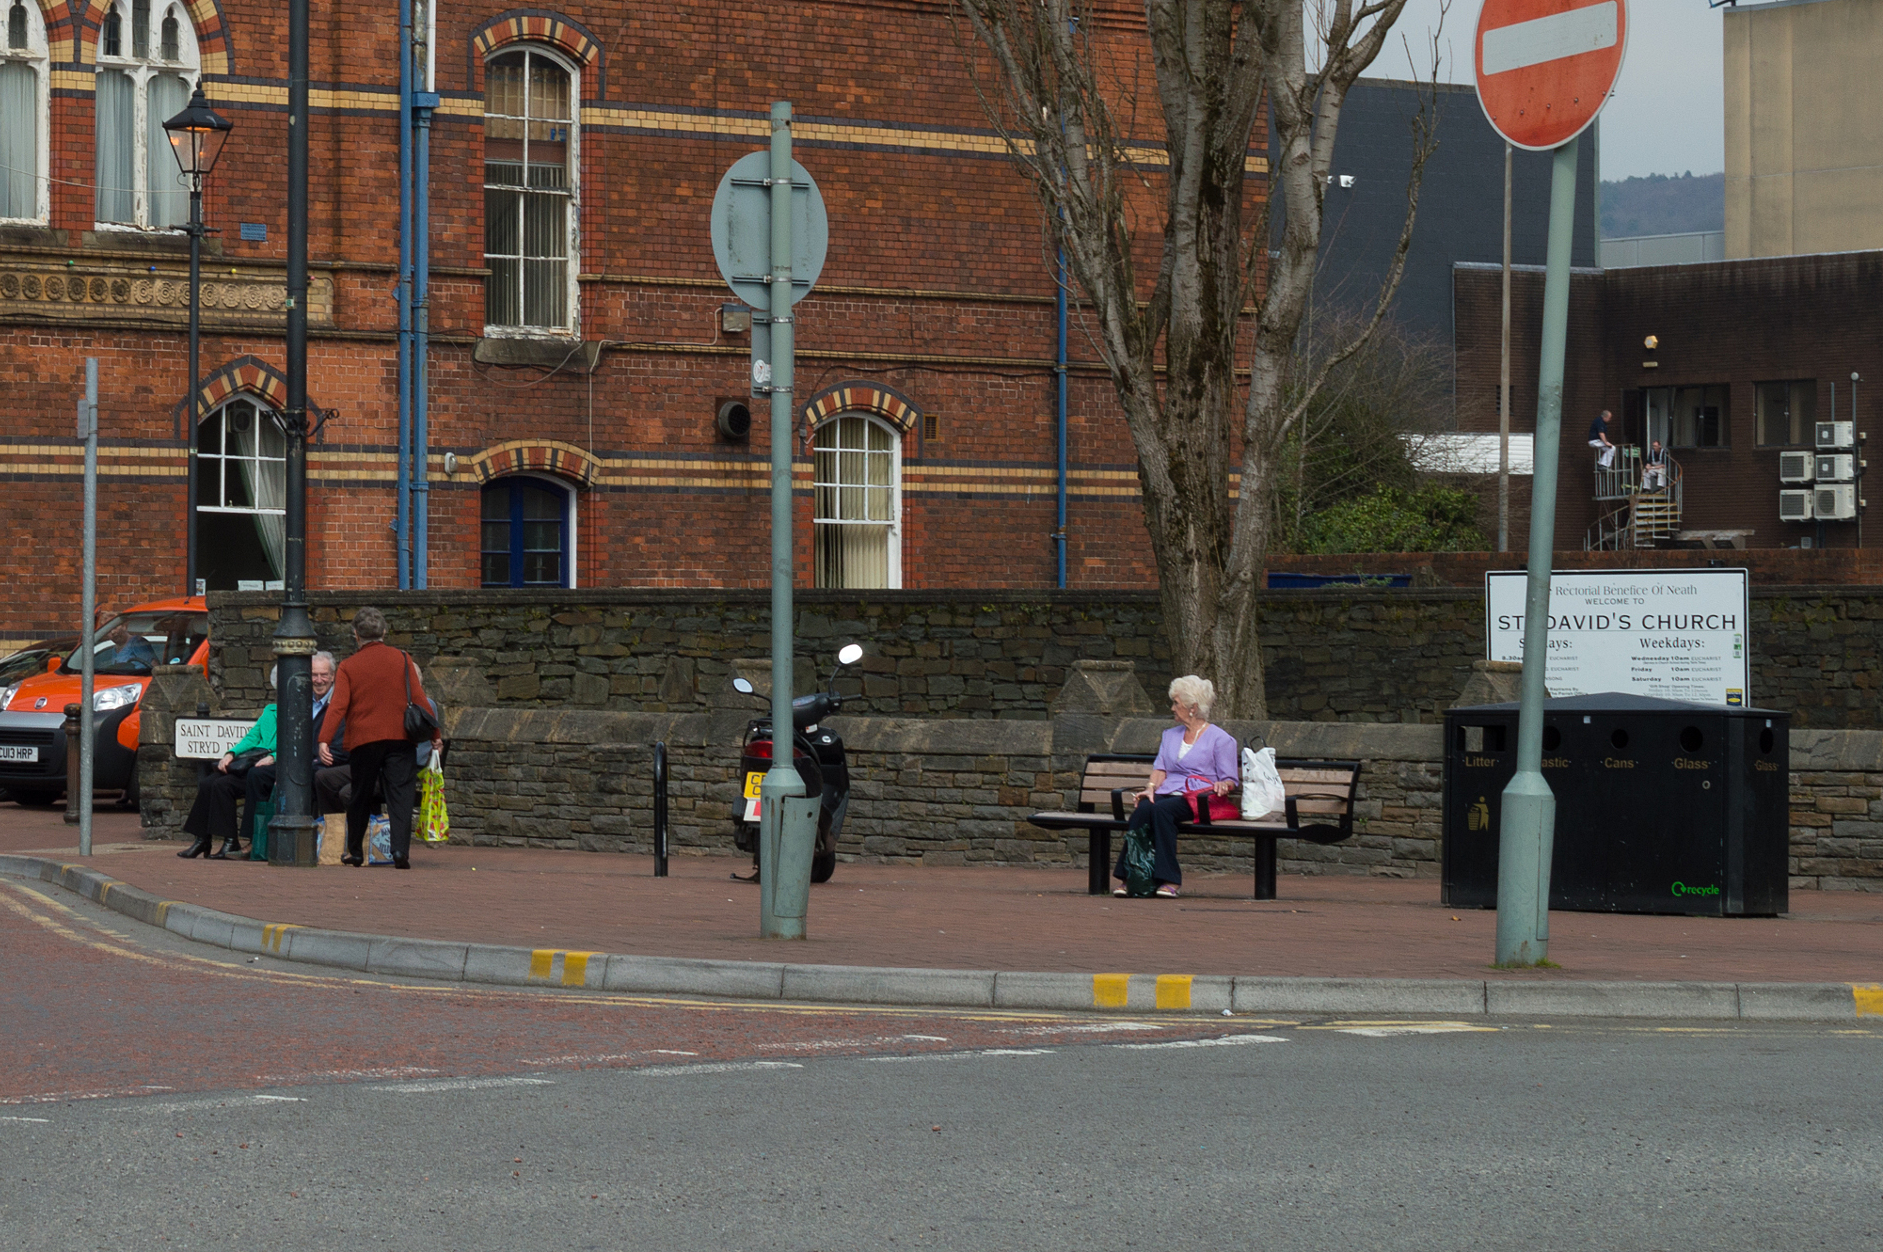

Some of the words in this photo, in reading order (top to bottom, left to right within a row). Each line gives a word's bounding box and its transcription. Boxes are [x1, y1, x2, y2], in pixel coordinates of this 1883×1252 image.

[1556, 586, 1601, 597] Rectorial
[1603, 585, 1648, 596] Benefice
[1651, 584, 1664, 596] Of
[1667, 584, 1697, 595] Neath
[1498, 615, 1525, 630] ST
[1547, 612, 1631, 630] DAVID'S
[1642, 614, 1736, 630] CHURCH
[1639, 636, 1705, 651] Weekdays:
[181, 724, 210, 737] SAINT
[17, 748, 33, 759] HRP
[188, 741, 220, 753] STRYD
[1465, 756, 1495, 768] Litter
[1542, 757, 1569, 768] astic
[1604, 757, 1634, 769] Cans
[1674, 757, 1709, 769] Glass
[1755, 760, 1778, 772] Glass
[1687, 884, 1720, 897] recycle
